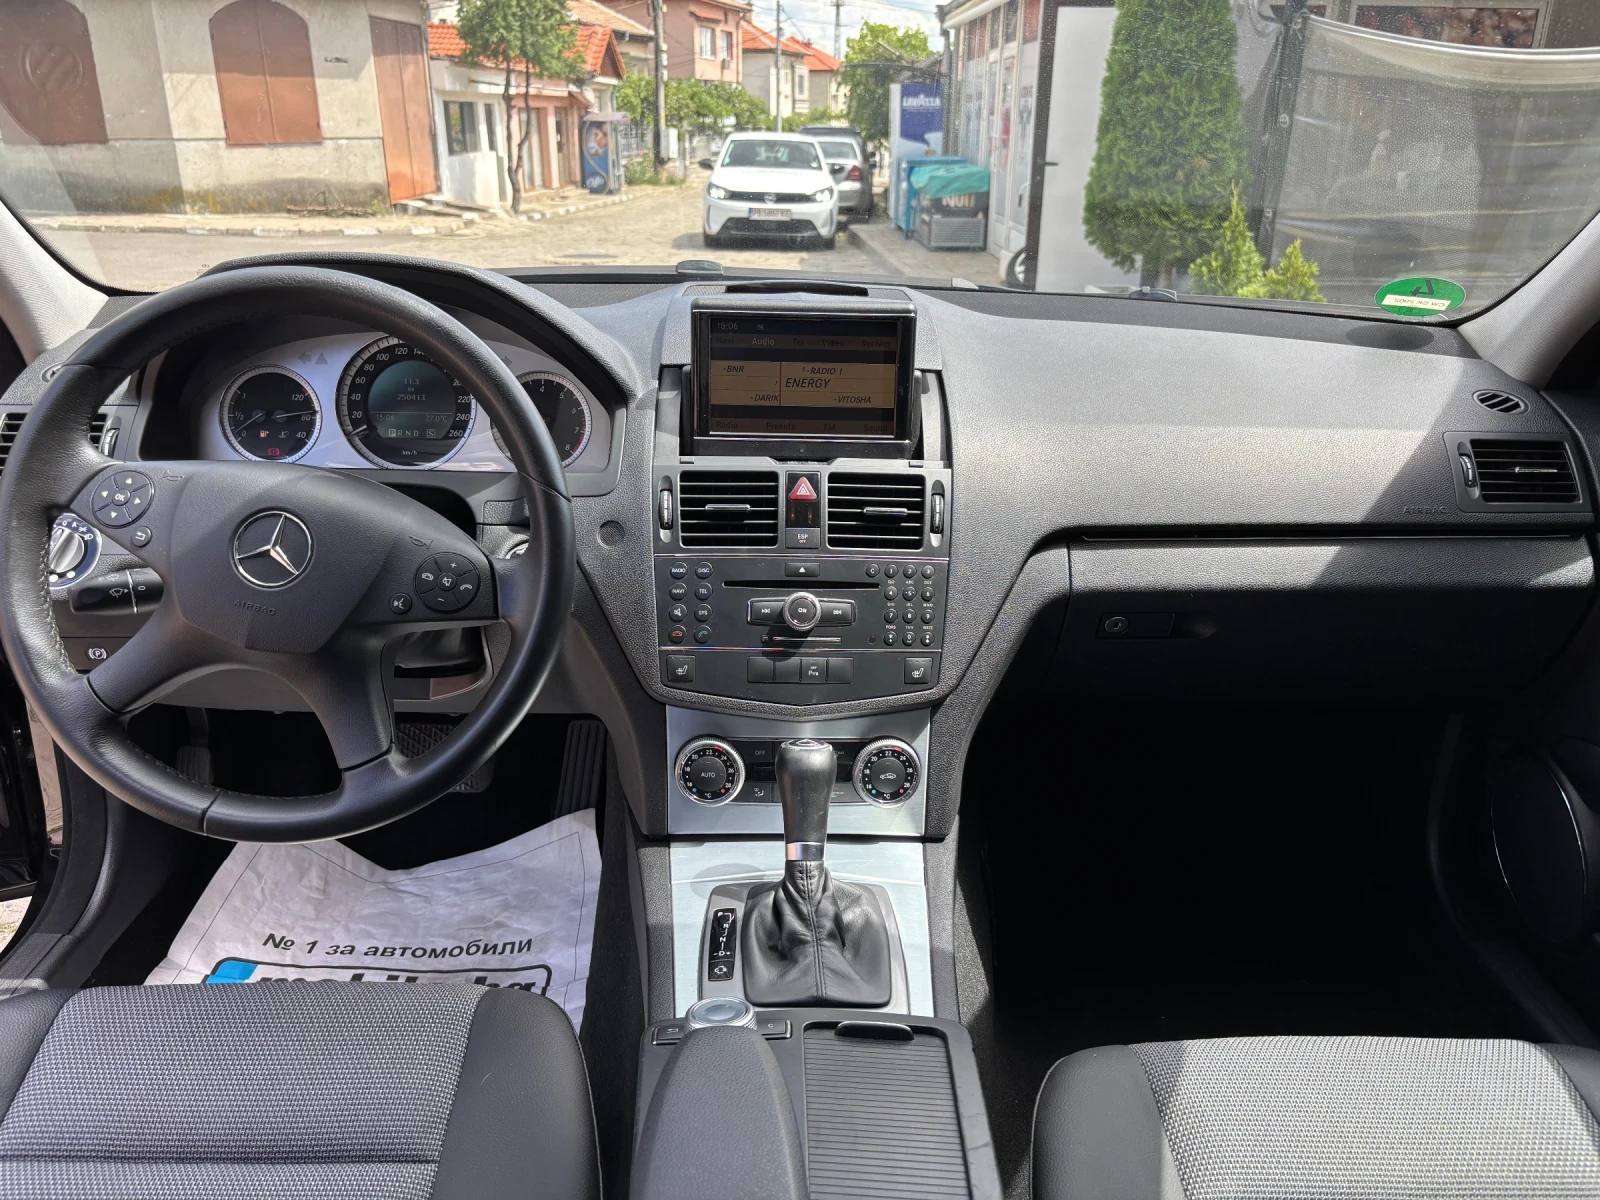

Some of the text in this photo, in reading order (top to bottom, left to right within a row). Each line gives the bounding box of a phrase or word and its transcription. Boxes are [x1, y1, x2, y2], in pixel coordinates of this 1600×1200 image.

[717, 321, 738, 330] 15:06
[716, 336, 891, 349] Navi Audio Tel Video System
[394, 347, 408, 355] 120
[376, 353, 389, 361] 100
[363, 363, 374, 371] 80
[355, 376, 366, 384] 60
[785, 377, 831, 388] ENERGY
[350, 393, 361, 401] 40
[397, 393, 426, 401] 250413
[457, 395, 470, 403] 220
[455, 413, 470, 421] 240
[574, 426, 579, 434] 7
[716, 421, 888, 432] Radio Presets FM Sound
[448, 429, 463, 437] 260
[114, 493, 126, 501] OK
[233, 599, 276, 616] AIRBAG
[262, 932, 533, 959] № 1 за автомобили
